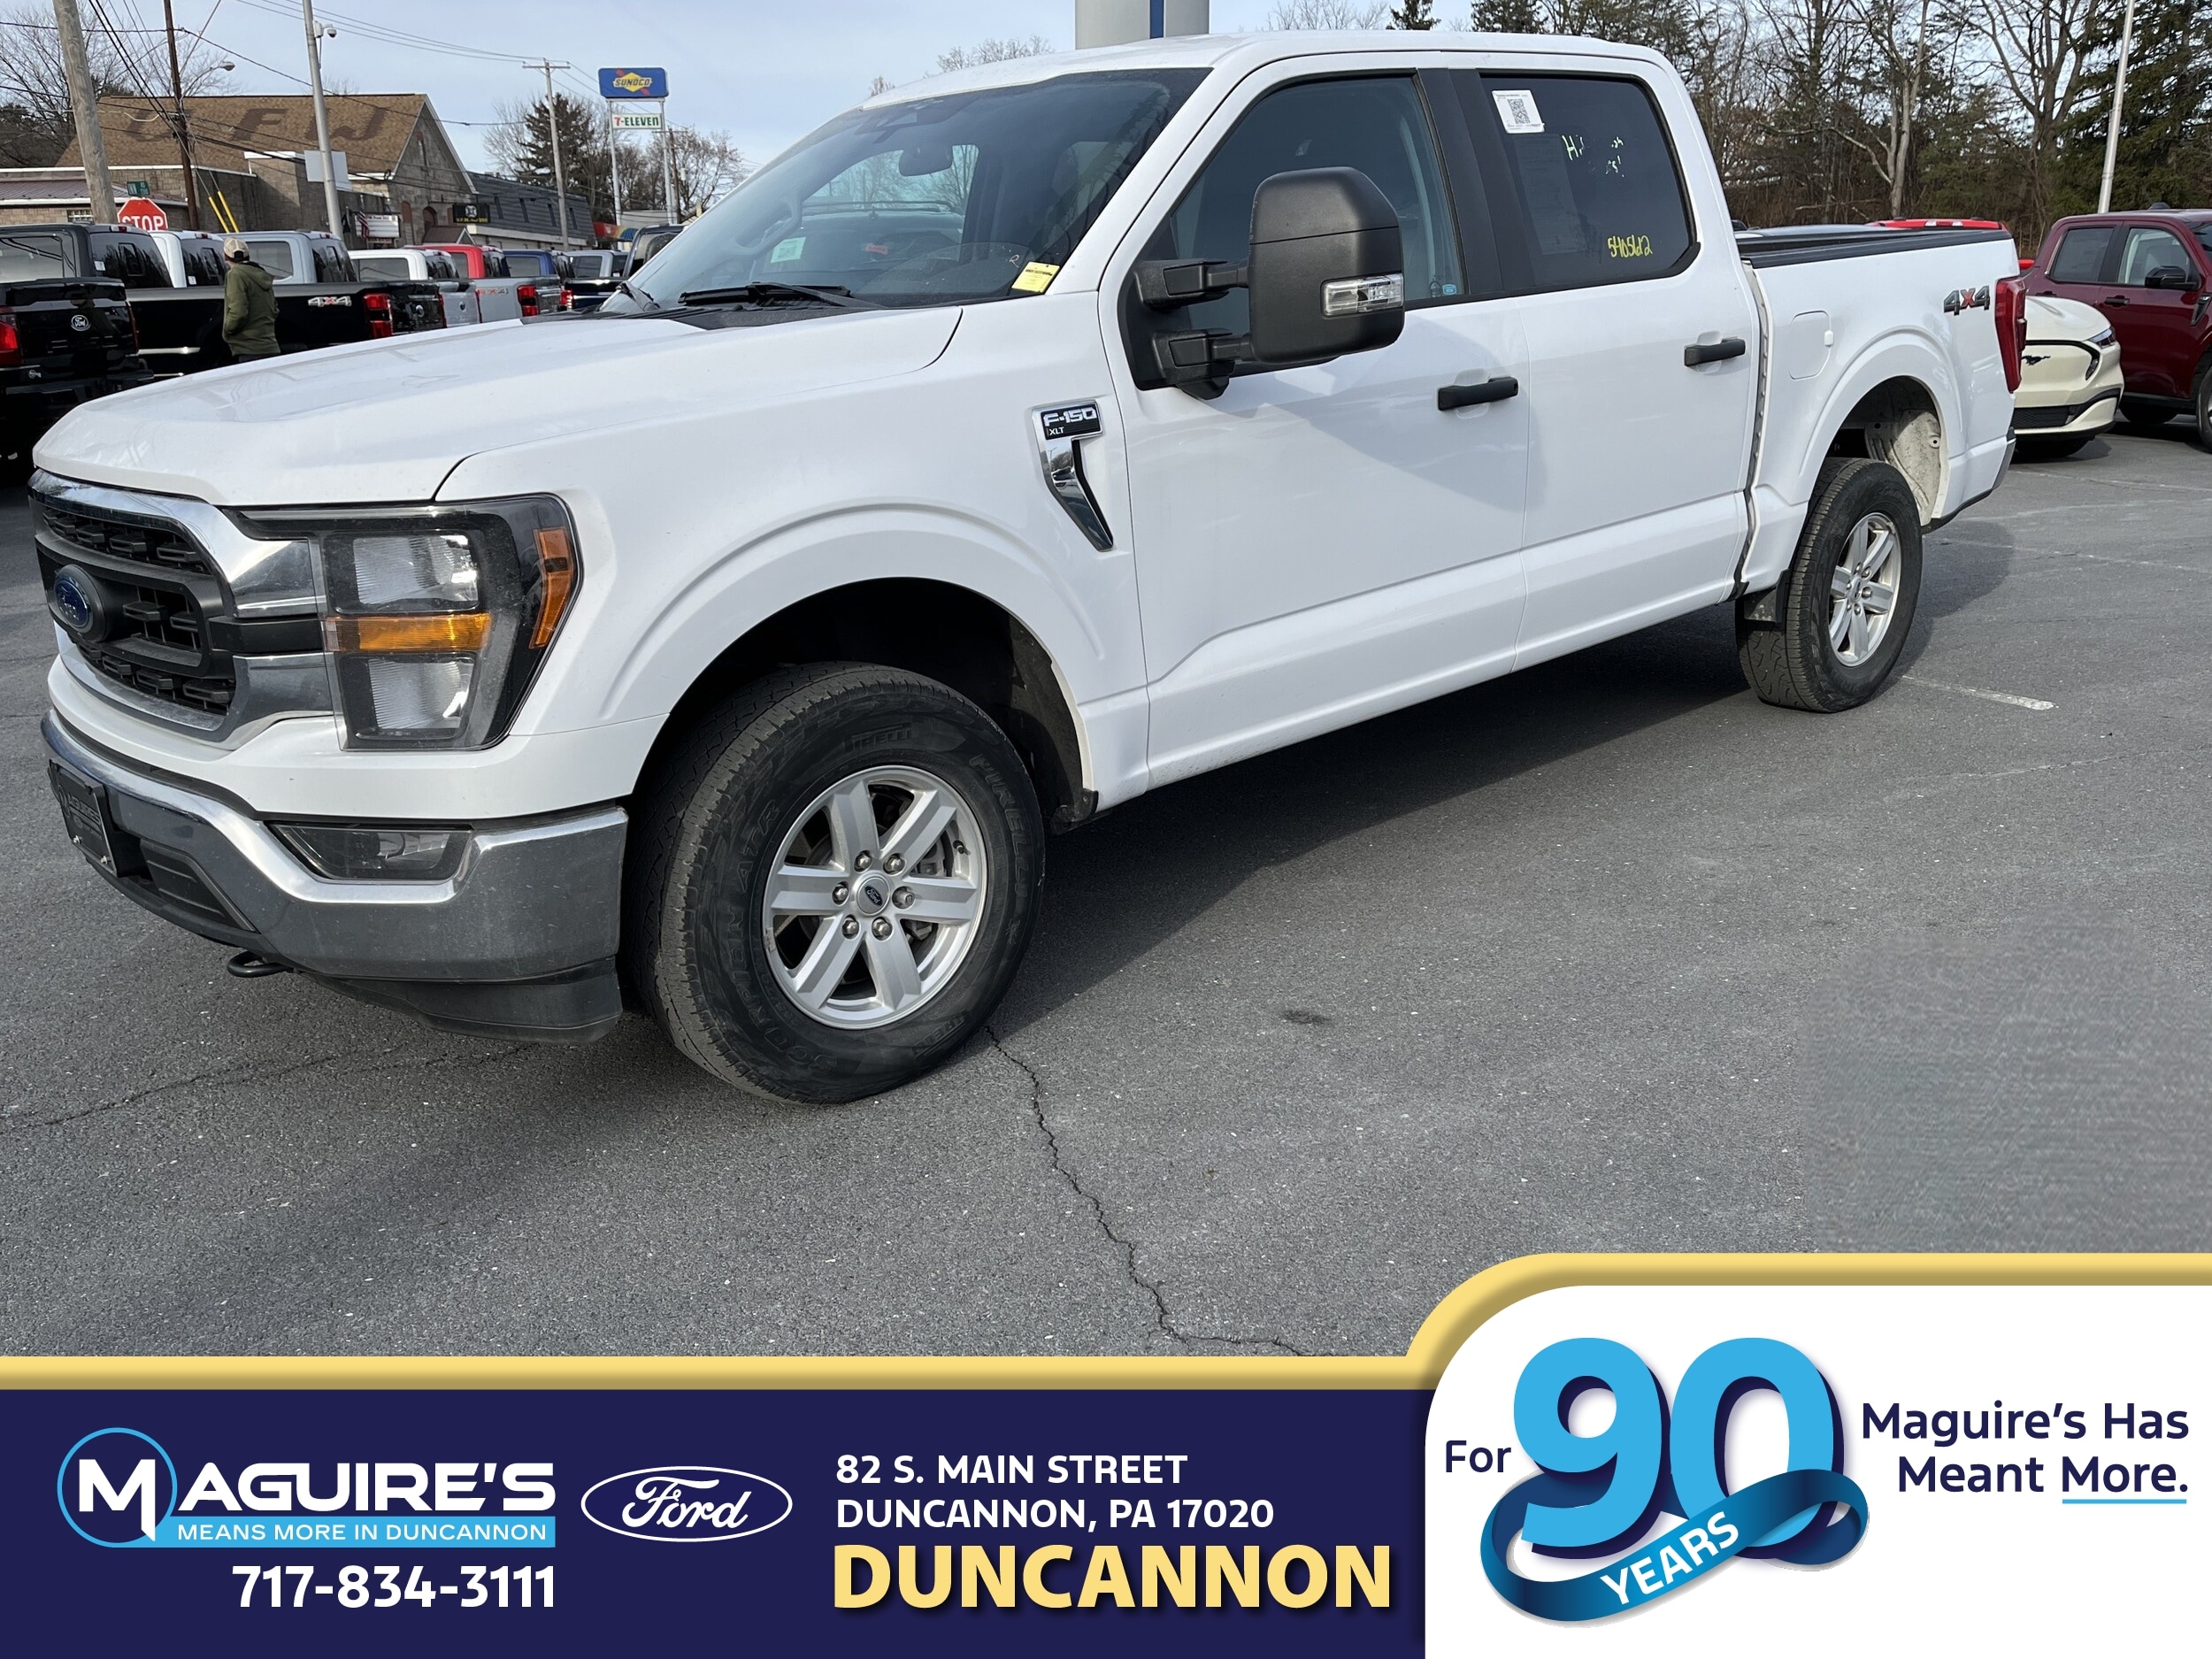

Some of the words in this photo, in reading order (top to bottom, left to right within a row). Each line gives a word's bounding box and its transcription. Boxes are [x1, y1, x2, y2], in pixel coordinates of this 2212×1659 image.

[614, 78, 651, 87] SUNOCO
[1043, 407, 1097, 426] F-150
[1048, 426, 1064, 435] XLT
